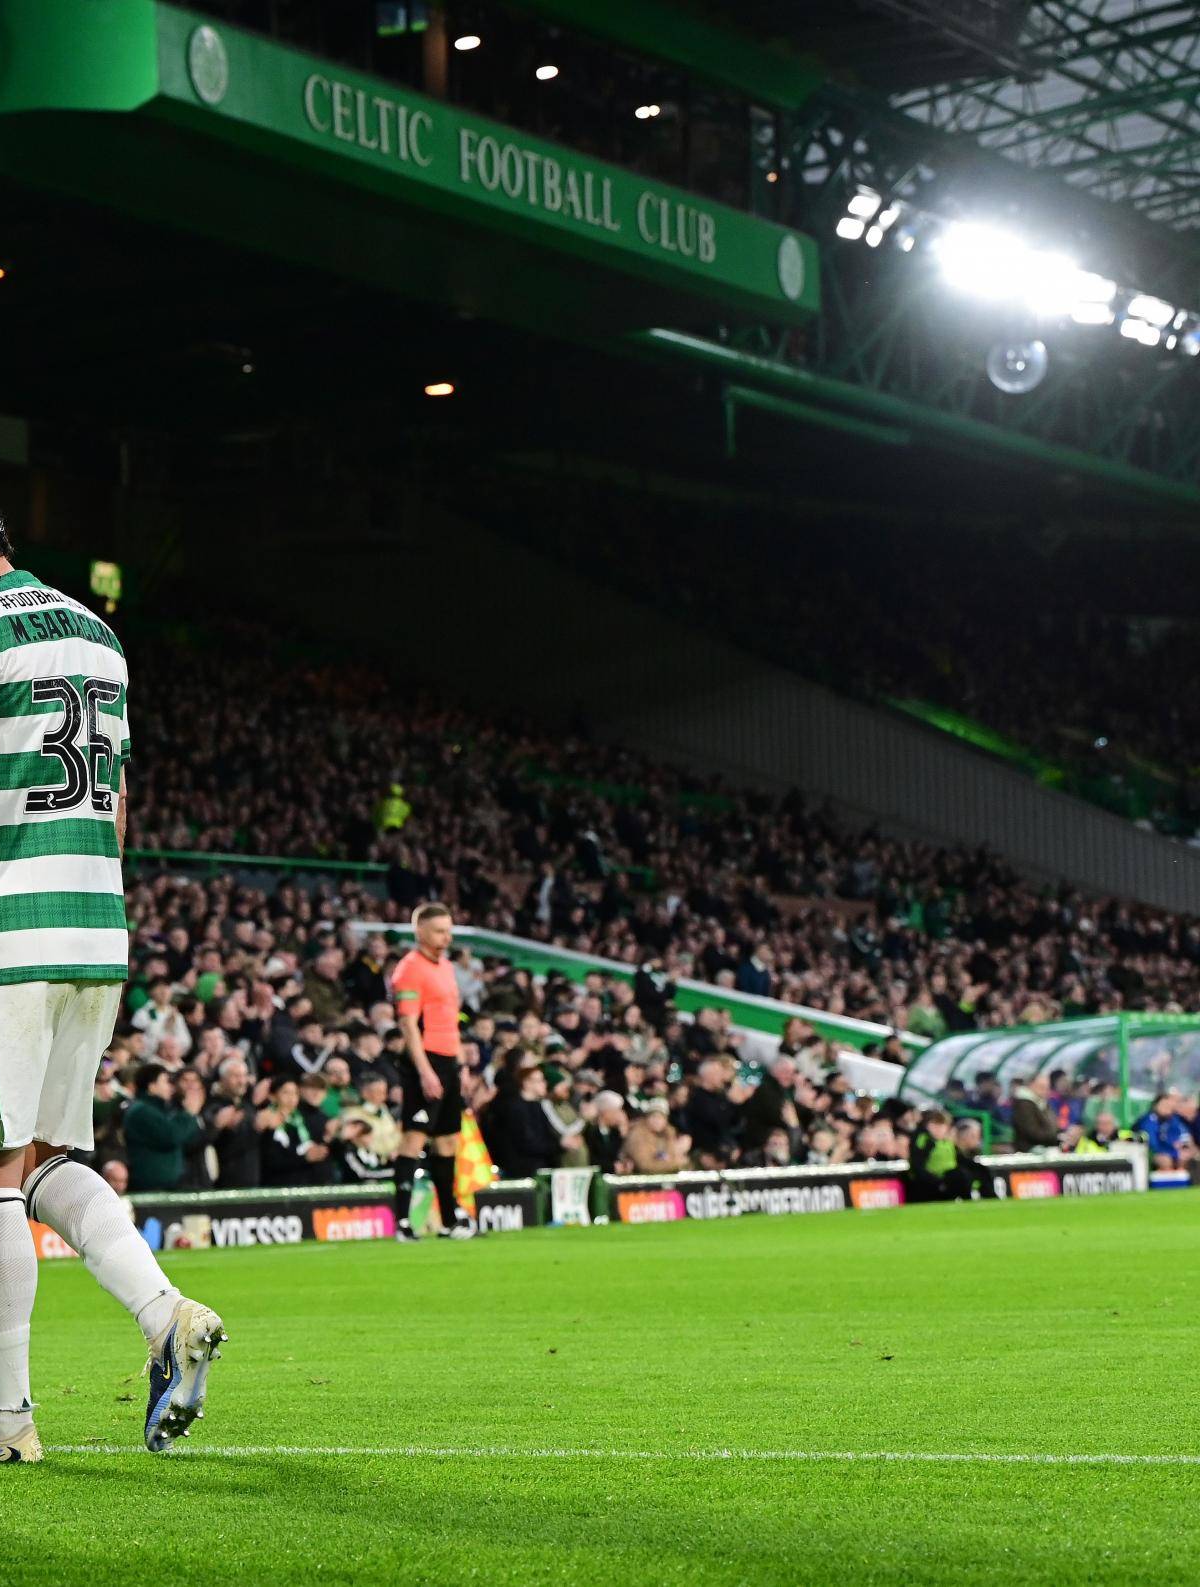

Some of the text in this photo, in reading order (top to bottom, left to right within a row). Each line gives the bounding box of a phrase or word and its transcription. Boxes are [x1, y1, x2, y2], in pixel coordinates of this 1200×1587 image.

[304, 73, 717, 263] CELTIC FOOTBALL CLUB
